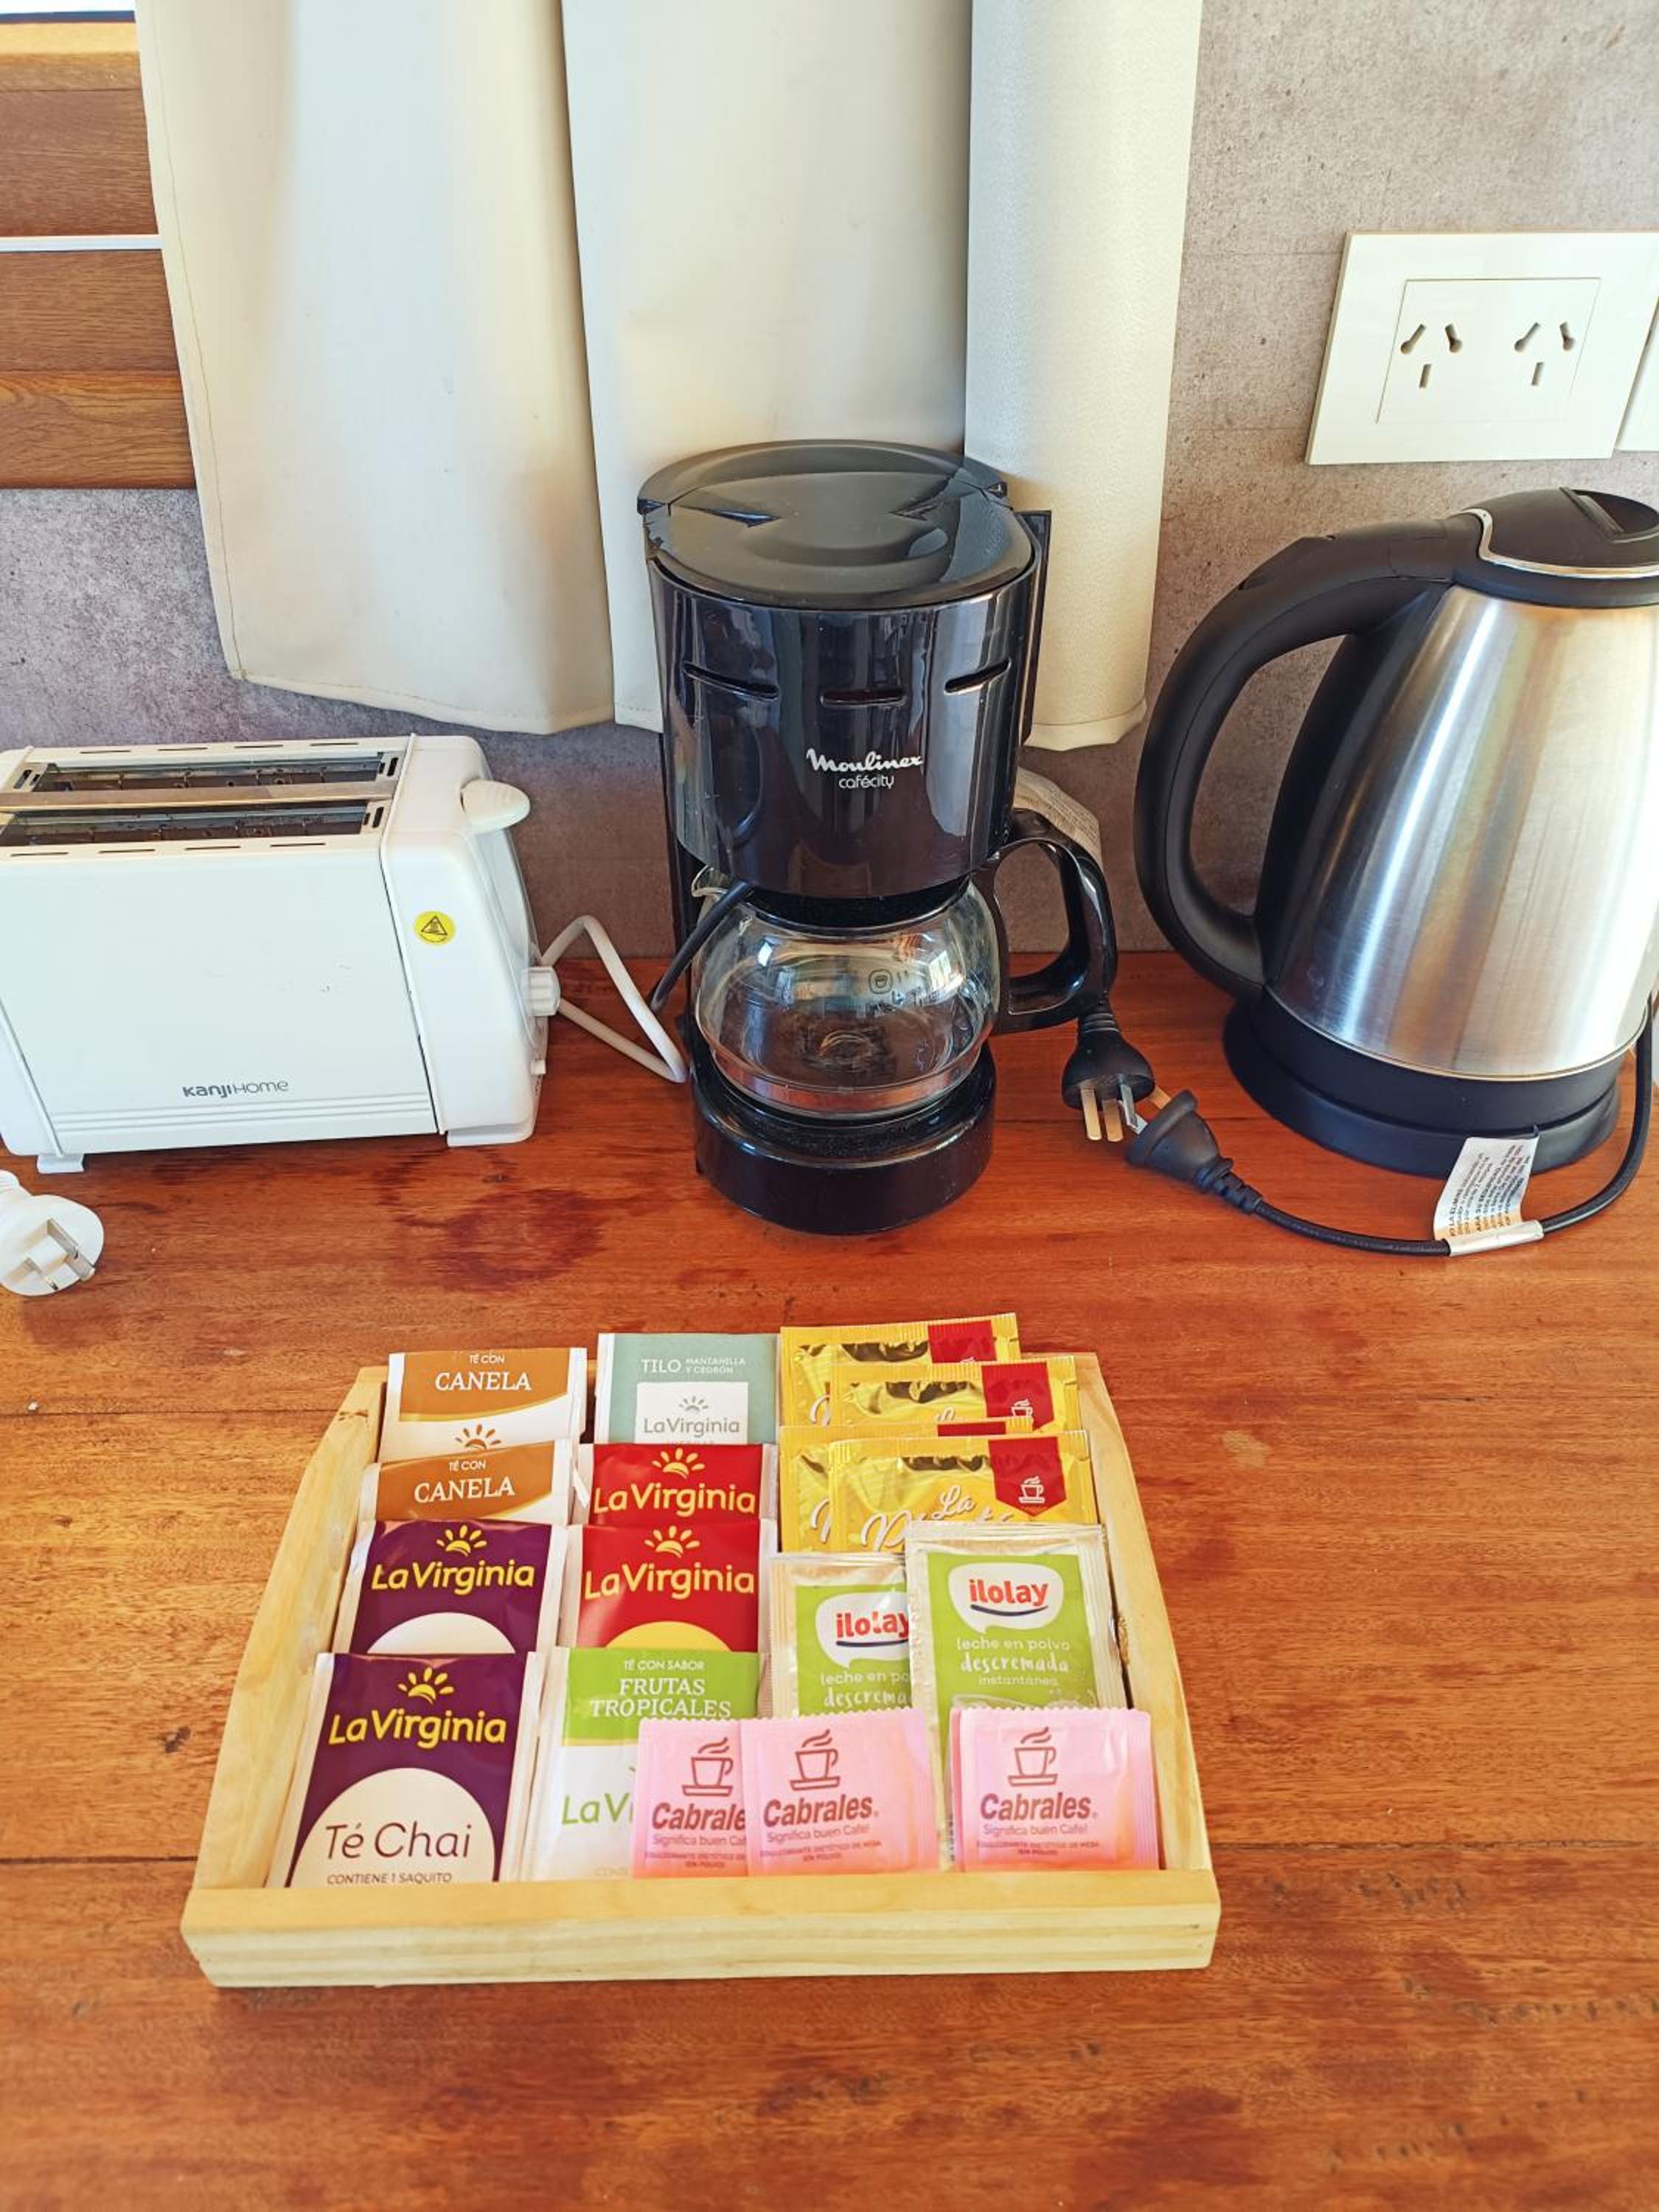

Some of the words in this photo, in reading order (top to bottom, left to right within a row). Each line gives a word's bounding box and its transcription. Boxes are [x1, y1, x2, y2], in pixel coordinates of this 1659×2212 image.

[806, 748, 923, 772] Moulinex
[641, 1358, 682, 1373] TILO
[435, 1371, 532, 1391] CANELA
[461, 1460, 487, 1470] CON
[414, 1476, 515, 1503] CANELA
[969, 1579, 1049, 1607] ilolay
[956, 1636, 1000, 1651] leche
[1004, 1640, 1023, 1650] en
[1027, 1638, 1071, 1652] polvo
[637, 1660, 664, 1671] CON
[667, 1660, 706, 1672] SABOR
[961, 1651, 1069, 1673] descremada
[619, 1677, 706, 1696] FRUTAS
[821, 1671, 863, 1686] leche
[867, 1673, 887, 1682] en
[824, 1687, 910, 1708] descrema
[589, 1698, 731, 1718] TROPICALES
[653, 1803, 745, 1830] Cabrale
[325, 1823, 364, 1860] Té
[374, 1820, 472, 1858] Chai
[327, 1873, 389, 1885] CONTIENE
[399, 1872, 452, 1884] SAQUITO
